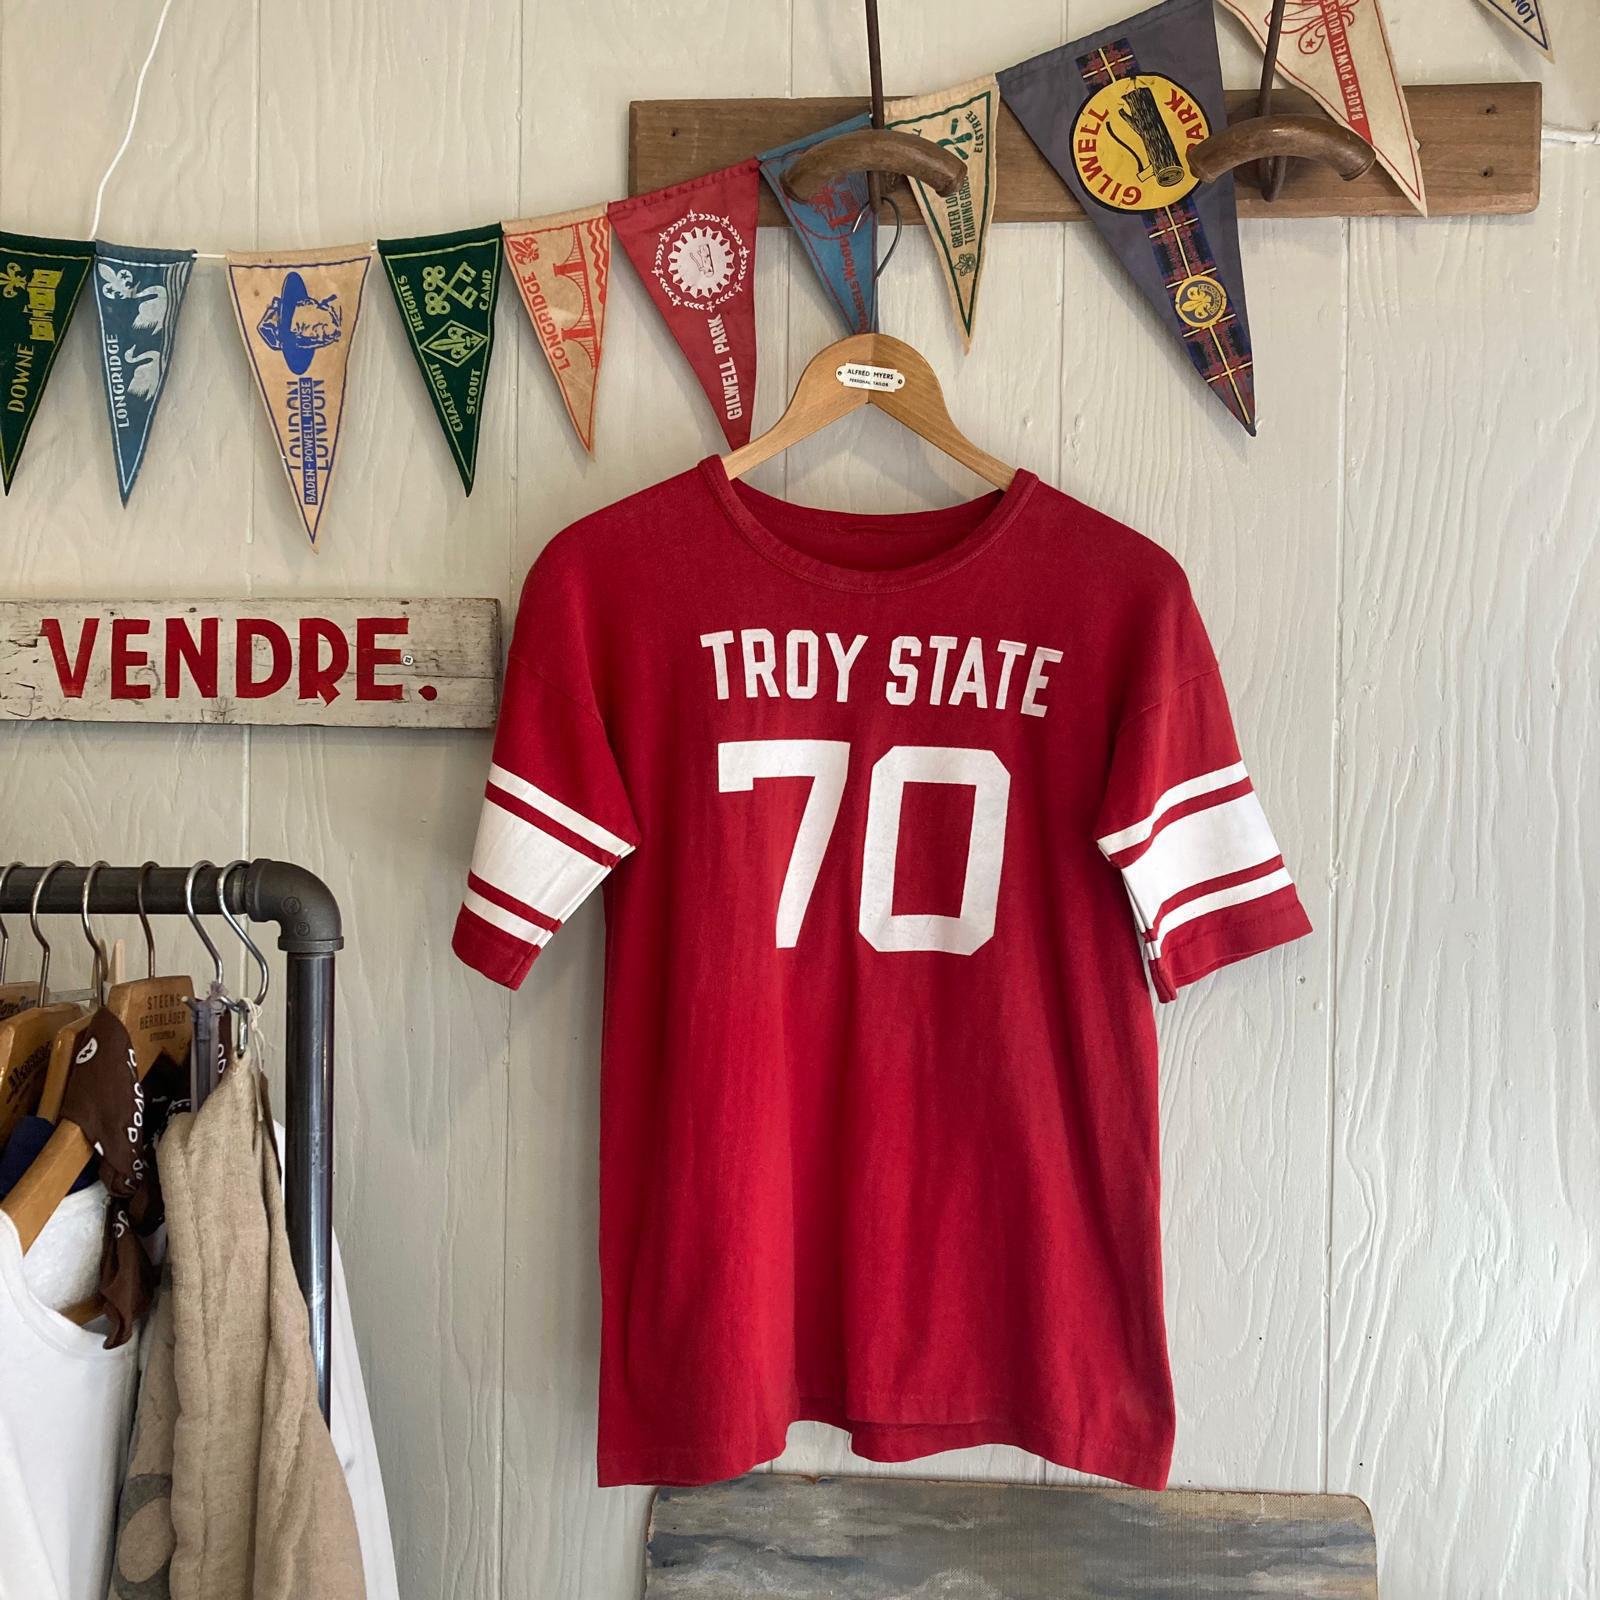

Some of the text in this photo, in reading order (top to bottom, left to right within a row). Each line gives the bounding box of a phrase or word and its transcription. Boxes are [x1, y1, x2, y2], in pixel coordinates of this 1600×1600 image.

[1332, 35, 1364, 120] BADEN-POWELL
[965, 110, 984, 154] ELSTREE
[1077, 88, 1205, 206] GILWELL ARK
[945, 191, 964, 249] GREATER LON
[960, 200, 975, 246] TRAINING
[397, 275, 463, 432] CHALFONT HEIGHTS
[466, 269, 492, 415] SCOUT CAMP
[523, 272, 569, 371] LONGRIDGE
[707, 313, 743, 420] GILWELL PARK
[7, 343, 34, 413] DOWNE
[106, 333, 130, 428] LONGRIDGE
[847, 368, 894, 380] ALFRED MYERS
[301, 380, 317, 503] BADEN-POWELL HOUSE
[39, 617, 438, 706] VENDRE.
[700, 628, 1064, 718] TROY STATE
[718, 739, 1012, 956] 70
